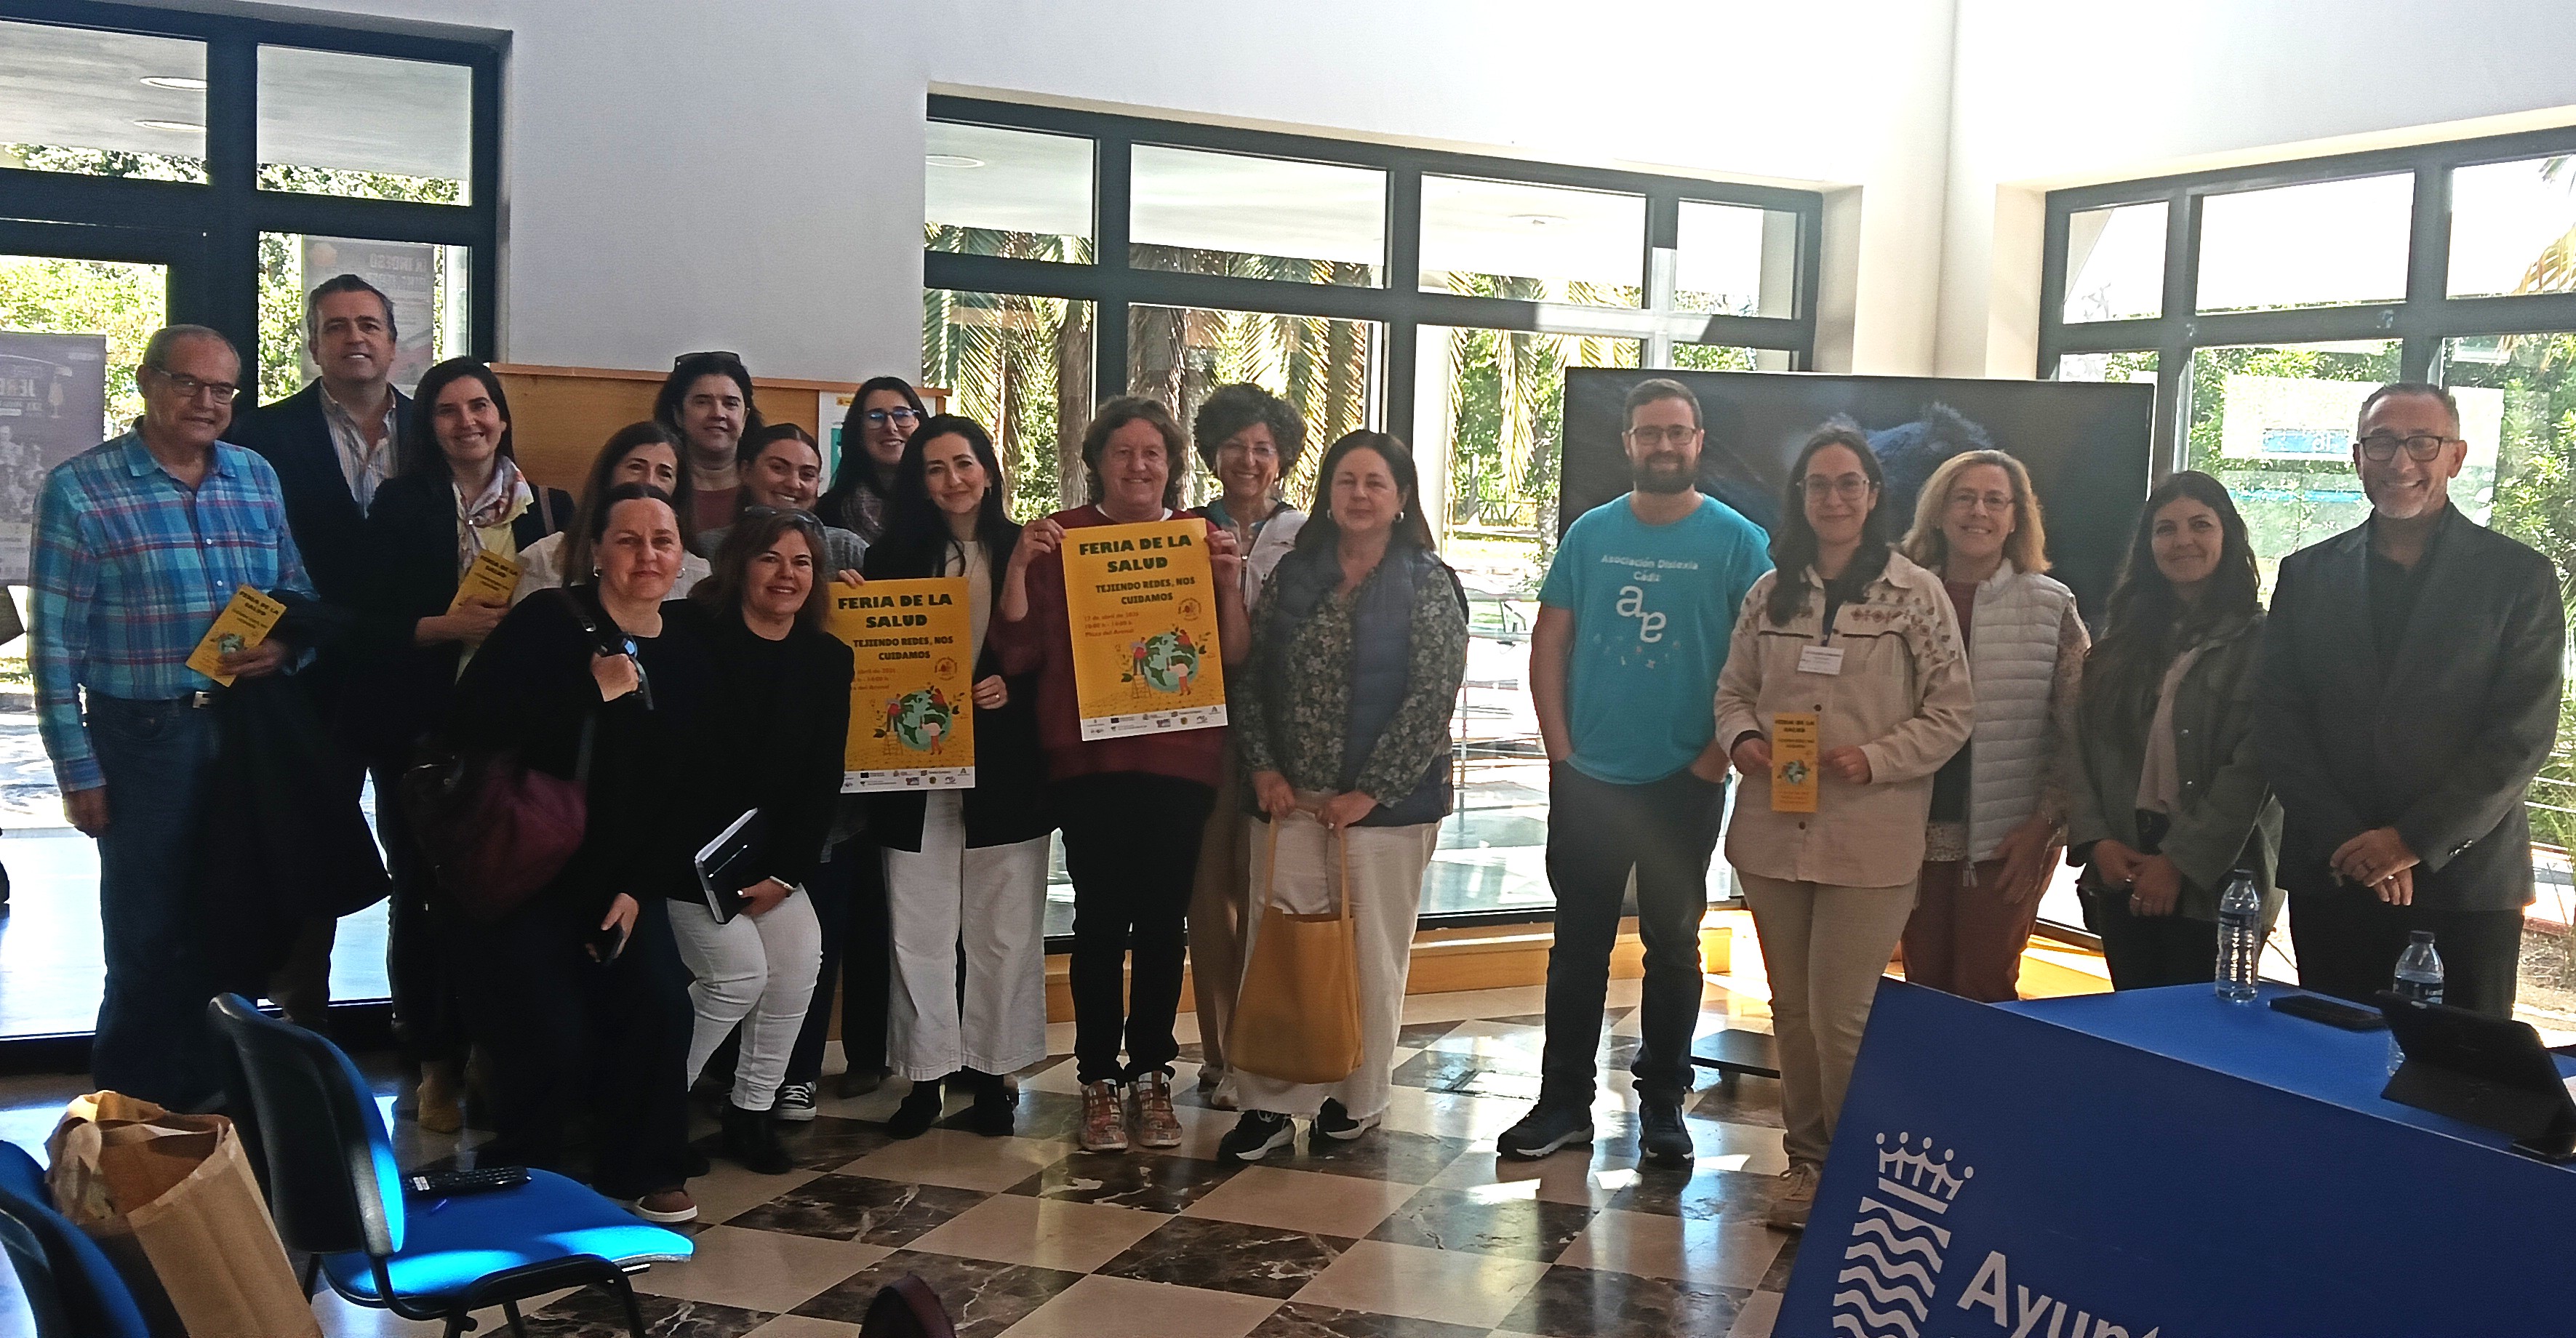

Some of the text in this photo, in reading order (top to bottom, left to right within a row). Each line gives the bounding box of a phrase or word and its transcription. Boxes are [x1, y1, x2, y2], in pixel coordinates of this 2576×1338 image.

[1079, 534, 1192, 555] FERIA DE LA
[1108, 556, 1168, 573] SALUD
[1601, 554, 1699, 570] Asociación Dislexia
[1633, 569, 1660, 582] Cádiz
[1095, 577, 1196, 593] TEJIENDO REDES, NOS
[838, 593, 953, 609] FERIA DE LA
[1121, 592, 1173, 605] CUIDAMOS
[866, 614, 927, 628] SALUD
[853, 638, 900, 648] TEJIENDO
[901, 637, 932, 646] REDES,
[879, 651, 931, 660] CUIDAMOS
[1956, 1251, 2159, 1338] Ayu
